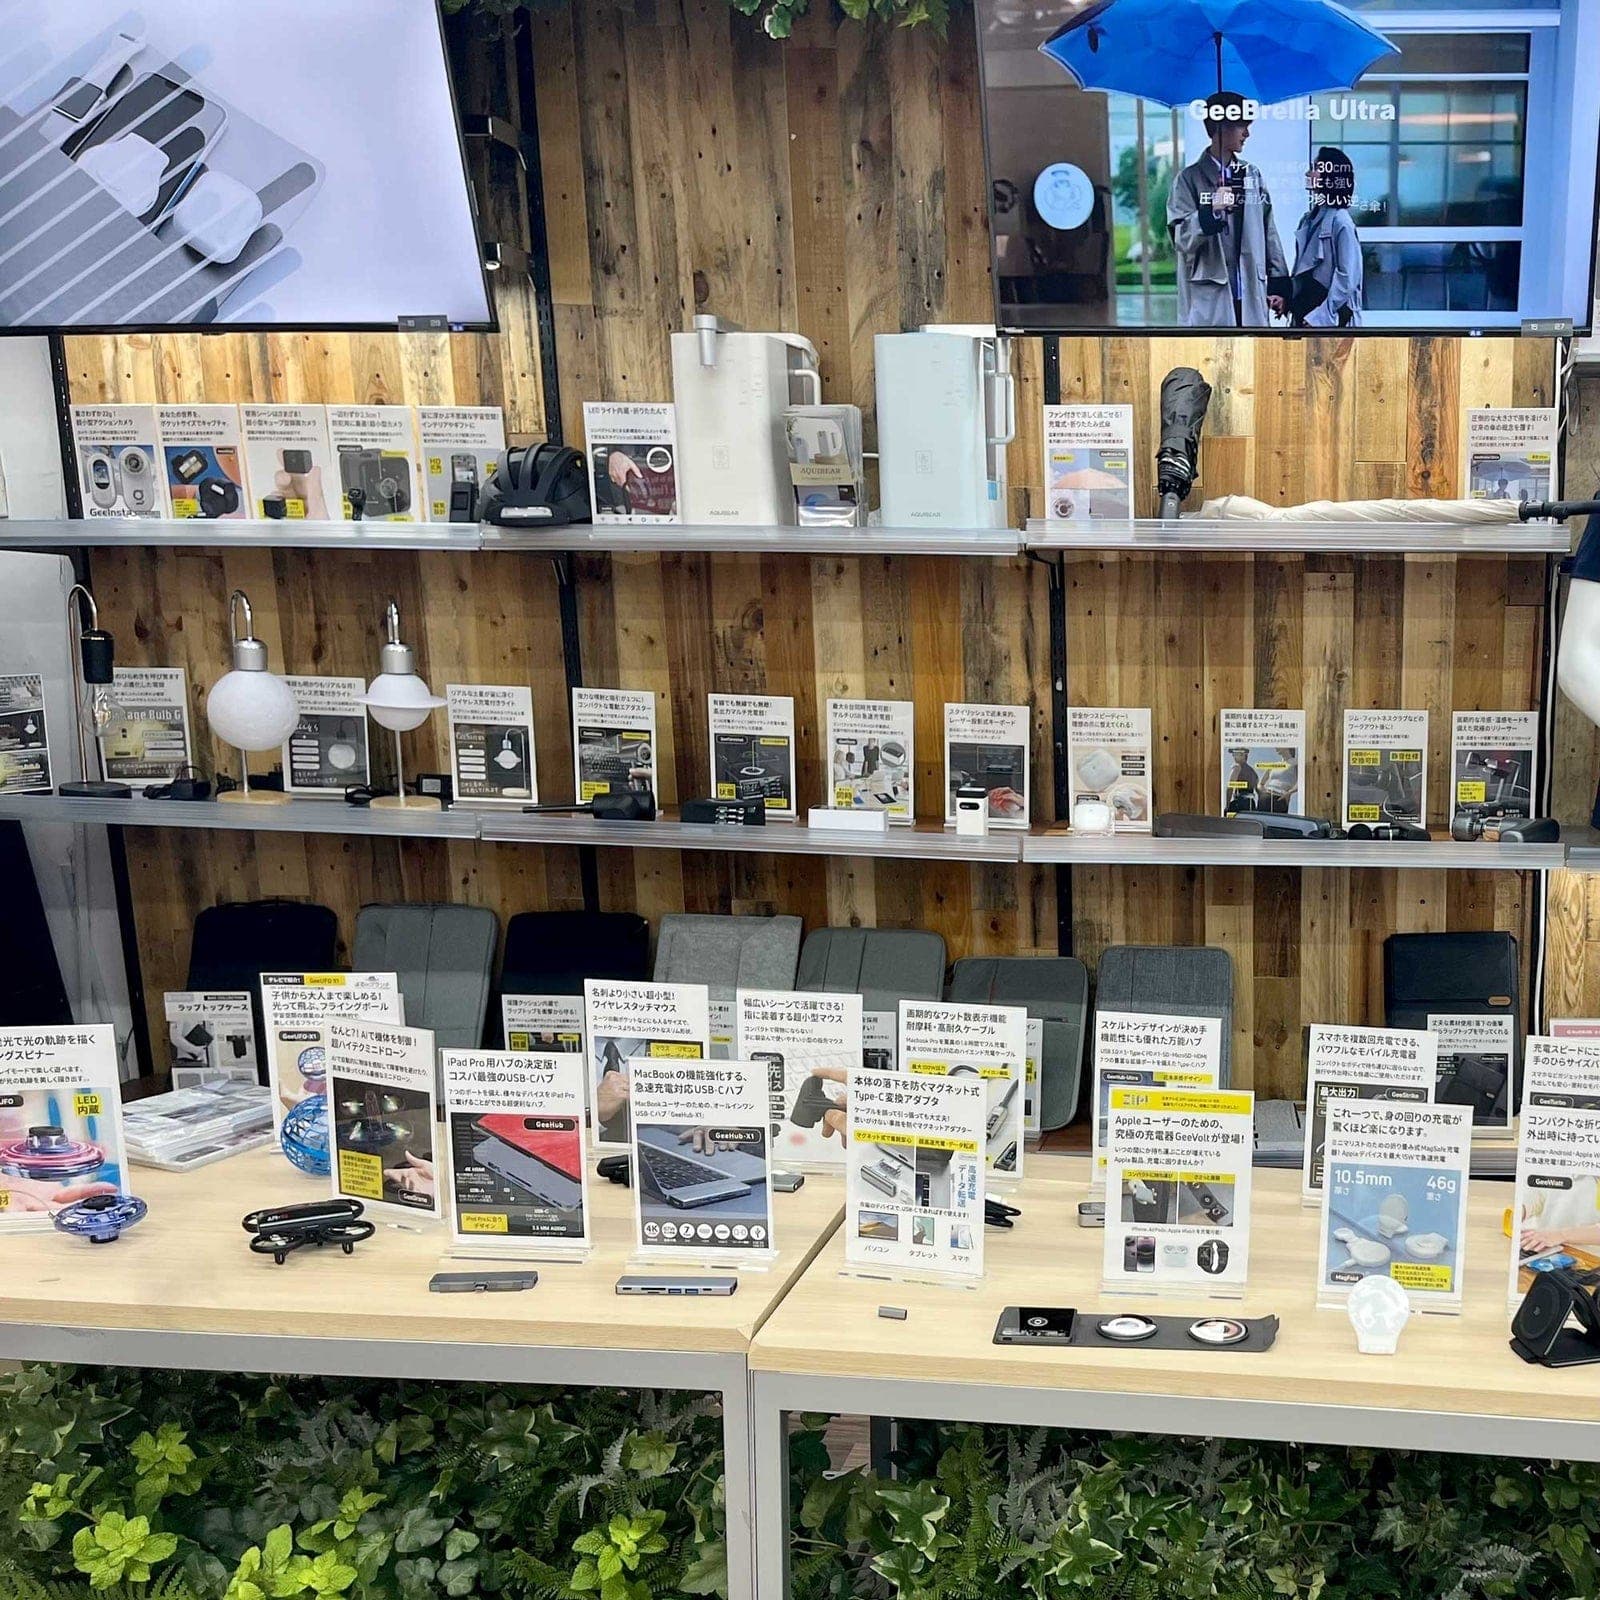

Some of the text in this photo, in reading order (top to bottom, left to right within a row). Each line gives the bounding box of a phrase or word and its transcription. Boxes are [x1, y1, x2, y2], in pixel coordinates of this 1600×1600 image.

[1188, 98, 1396, 121] GeeBrella Ultra
[592, 987, 675, 1001] 名刺より小さい超小型!
[592, 1000, 677, 1013] ワイヤレスタッチマウス
[743, 998, 845, 1011] 幅広いシーンで活躍できる!
[744, 1010, 843, 1024] 指に装着する超小型マウス
[906, 1008, 1007, 1024] 画期的なワット数表示機能
[906, 1021, 996, 1035] 耐摩耗・高耐久ケーブル
[1101, 1020, 1208, 1034] スケルトンデザインが決め手
[1101, 1033, 1202, 1047] 機能性にも優れた万能ハブ
[1317, 1032, 1420, 1048] スマホを複数回充電できる、
[1316, 1045, 1417, 1060] パワフルなモバイル充電器
[448, 1057, 558, 1071] iPad Pro 用ハブの決定版!
[449, 1071, 555, 1084] コスパ最強のUSB-Cハブ
[634, 1069, 748, 1082] MacBookの機能強化する、
[635, 1082, 744, 1095] 急速充電対応USB-Cハブ
[854, 1075, 980, 1097] 本体の落下を防ぐマグネット式
[79, 1096, 98, 1106] LED
[854, 1090, 940, 1106] Type-C変換アダプタ
[1115, 1115, 1224, 1129] Appleユーザーのための、
[1333, 1108, 1463, 1125] これ一つで、身の回りの充電が
[1115, 1128, 1245, 1144] 究極の充電器GeeVoltが登場!
[1333, 1122, 1428, 1138] 驚くほど楽になります。
[1334, 1169, 1457, 1194] 10.5mm 46g
